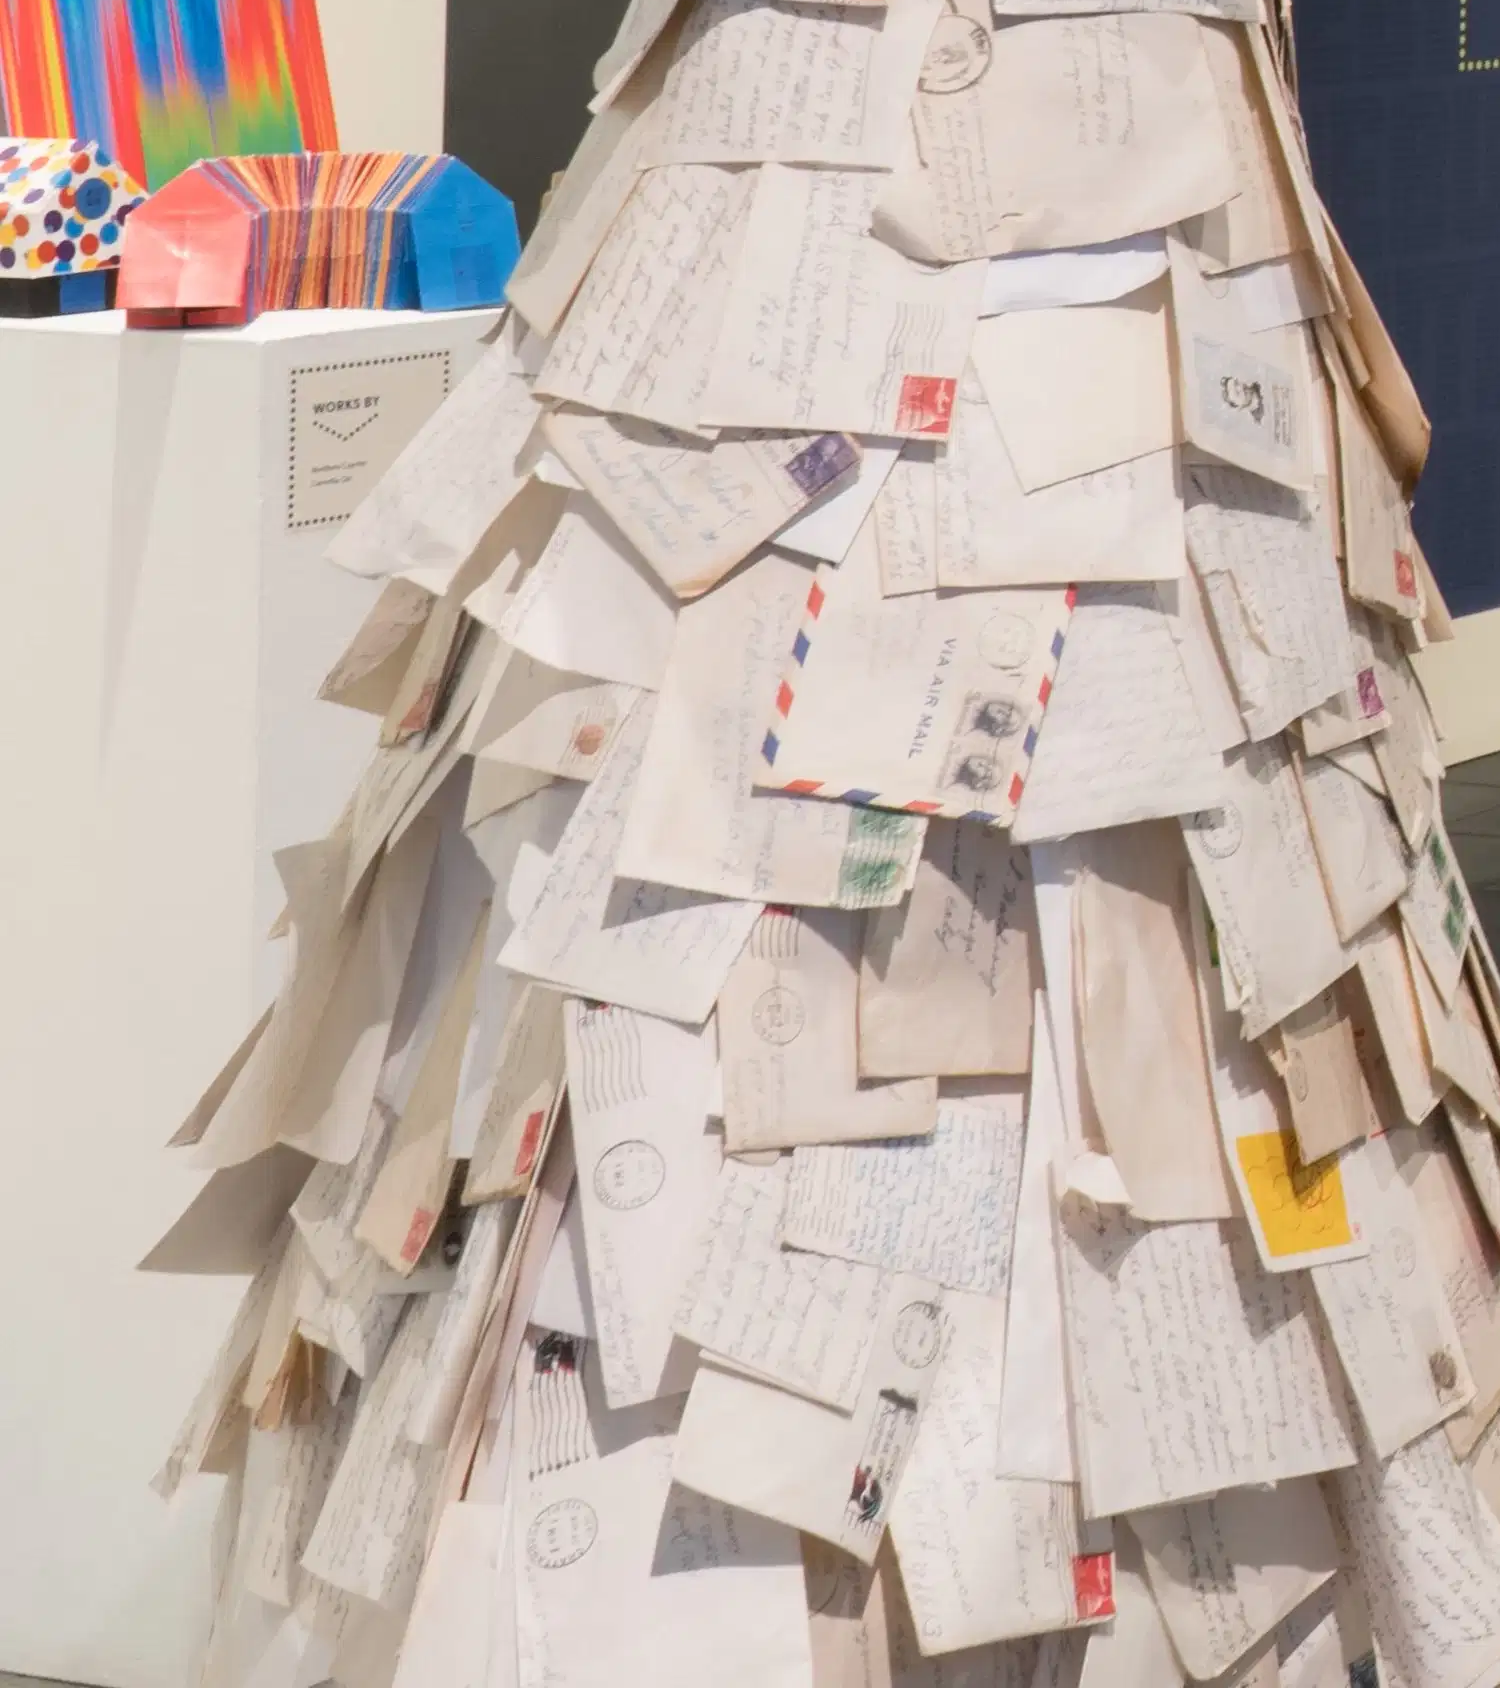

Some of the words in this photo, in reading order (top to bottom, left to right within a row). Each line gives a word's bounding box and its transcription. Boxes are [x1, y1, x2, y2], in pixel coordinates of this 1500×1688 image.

[312, 398, 361, 414] WORKS
[363, 396, 380, 409] BY
[936, 638, 957, 668] VIA
[924, 673, 945, 708] AIR
[908, 712, 933, 760] MAIL
